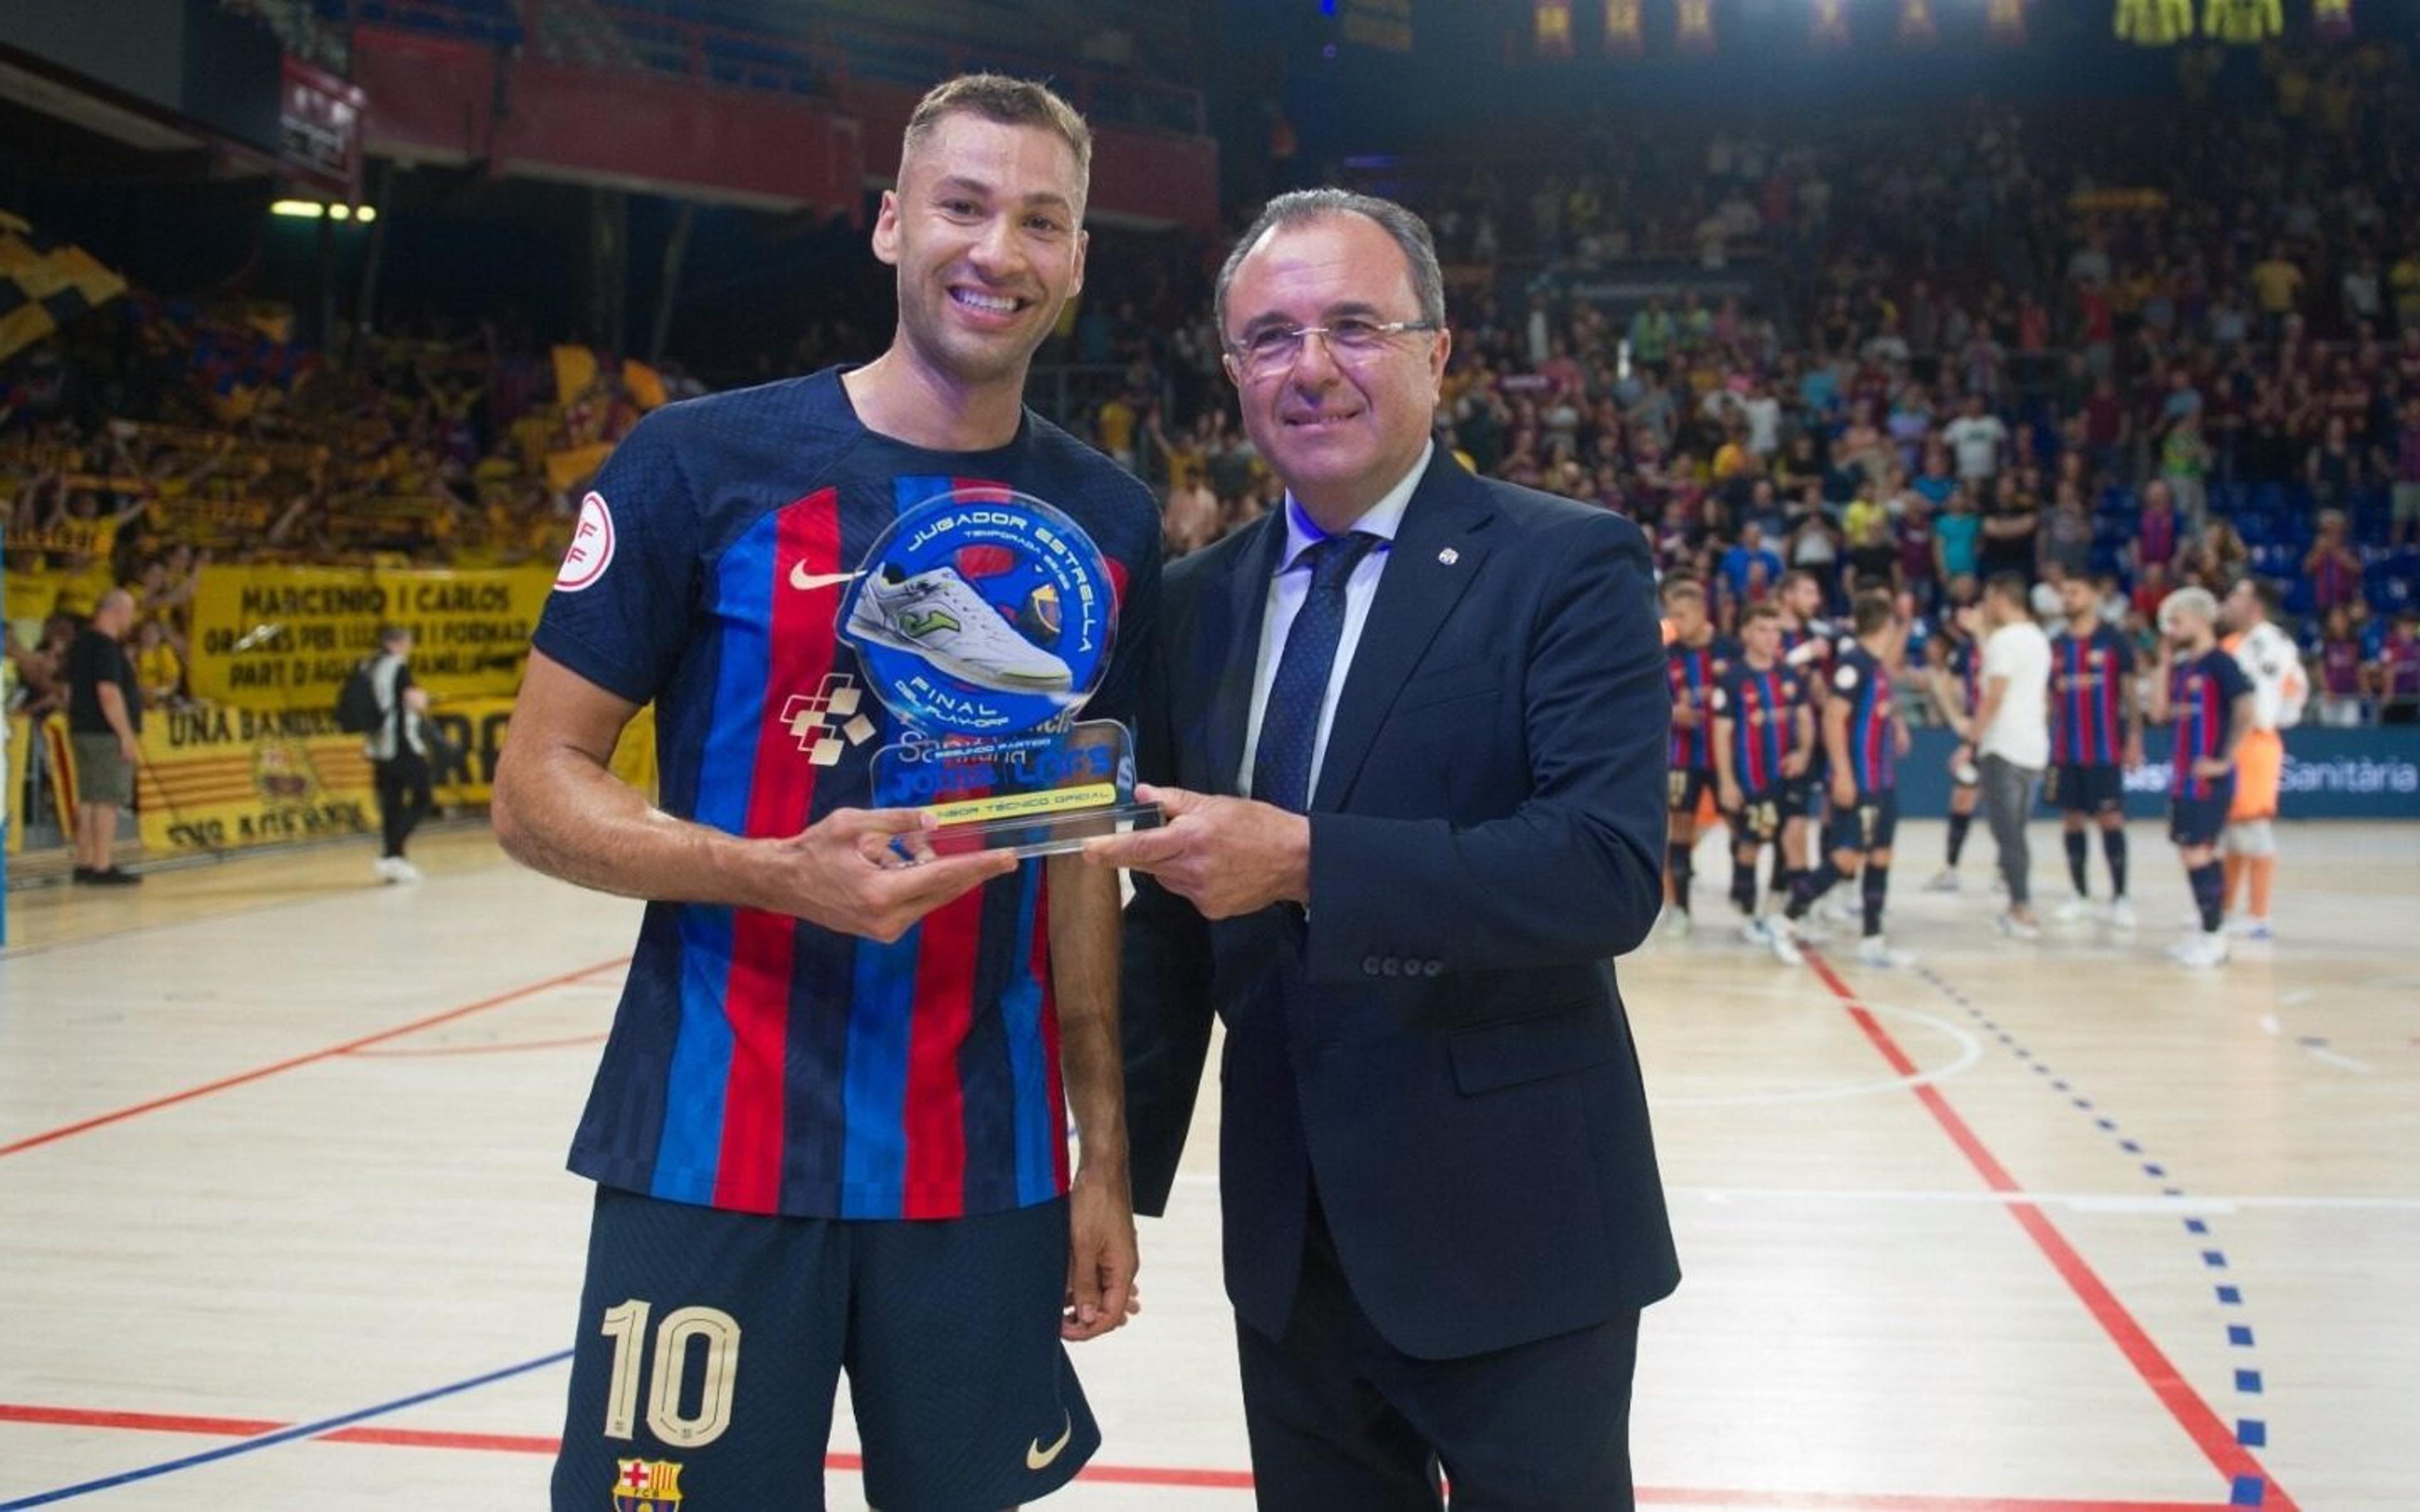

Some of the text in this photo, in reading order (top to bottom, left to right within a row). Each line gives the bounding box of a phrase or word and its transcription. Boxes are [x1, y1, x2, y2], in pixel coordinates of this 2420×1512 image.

[964, 530, 1041, 554] TEMPORADA
[241, 585, 386, 616] MARCENIO
[415, 585, 510, 612] CARLOS
[908, 511, 1097, 653] JUGADOR ESTRELLA
[910, 676, 998, 716] FINAL
[169, 709, 232, 747] UNA
[601, 1298, 742, 1448] 10
